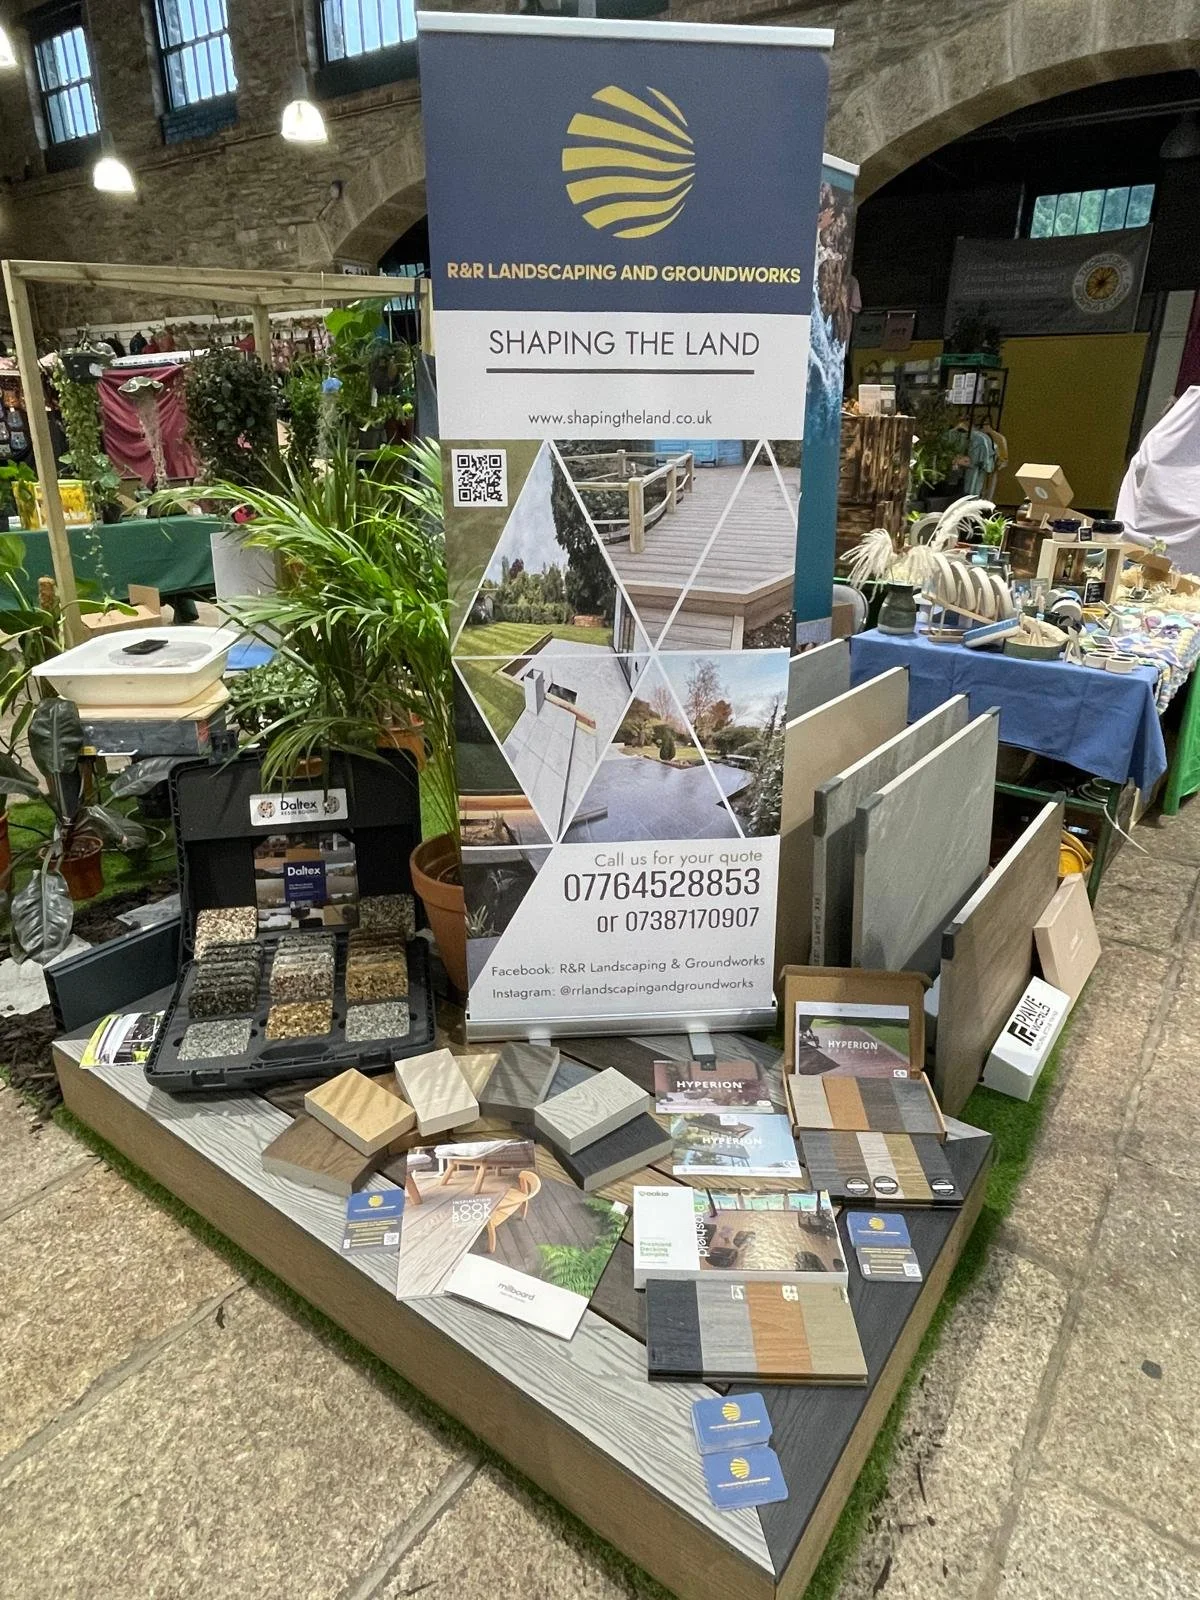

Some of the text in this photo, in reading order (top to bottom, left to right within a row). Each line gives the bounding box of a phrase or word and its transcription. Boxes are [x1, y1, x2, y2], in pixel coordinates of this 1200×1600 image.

[447, 262, 801, 284] R&R LANDSCAPING AND GROUNDWORKS
[489, 329, 760, 356] SHAPING THE LAND
[528, 410, 713, 428] www.shapingtheland.co.uk
[280, 797, 317, 811] Daltex
[594, 850, 762, 868] Call us for your quote
[287, 865, 321, 876] Daltex
[564, 867, 761, 902] 07764528853
[597, 906, 760, 933] or 07387170907
[491, 954, 766, 977] Facebook: R&R Landscaping & Groundworks
[492, 978, 754, 1000] Instagram: @rrlandscapingandgroundworks
[1014, 995, 1042, 1027] PAVE
[828, 1039, 879, 1051] HYPERION
[676, 1080, 743, 1089] HYPERION
[702, 1136, 762, 1145] HYPERION
[452, 1202, 491, 1214] LOOK
[452, 1211, 492, 1223] BOOK
[694, 1204, 711, 1257] Proshield
